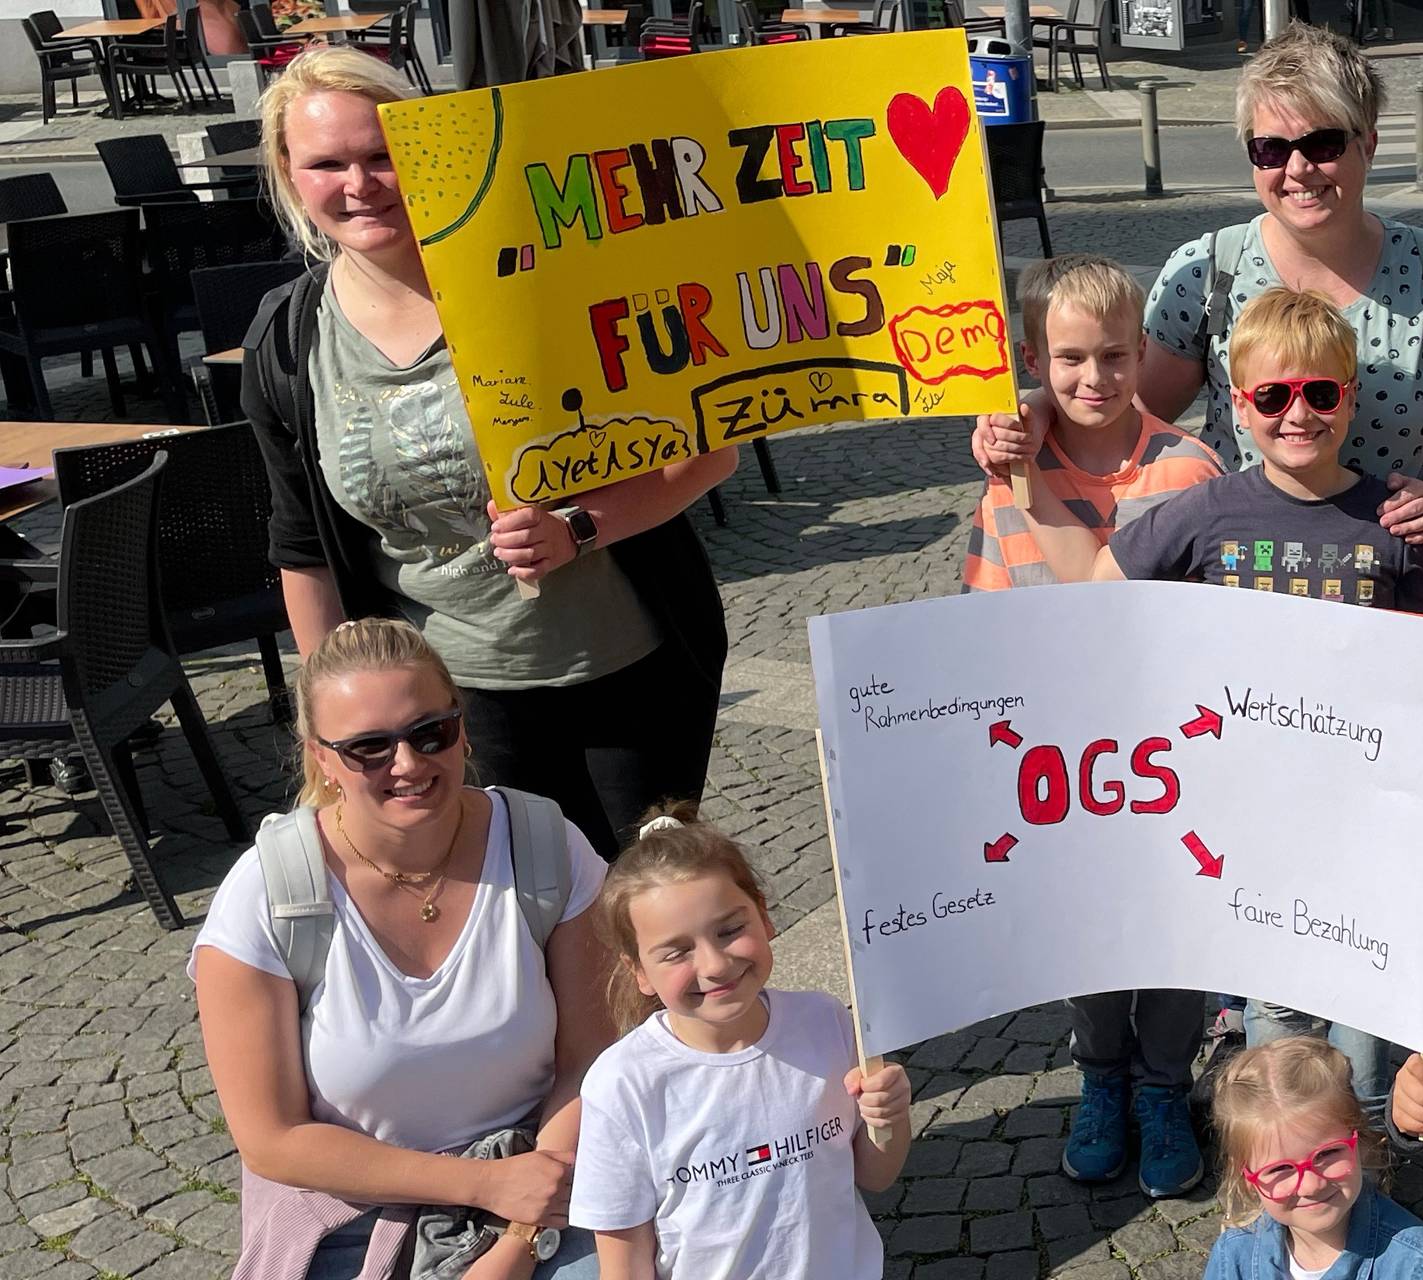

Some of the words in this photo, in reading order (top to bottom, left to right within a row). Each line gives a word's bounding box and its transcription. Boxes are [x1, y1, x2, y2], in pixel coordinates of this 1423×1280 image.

[728, 118, 876, 204] ZEIT
[920, 260, 957, 295] Maja
[590, 281, 729, 392] FÜR
[900, 311, 1006, 363] Demo
[716, 388, 897, 440] Zümra
[440, 564, 468, 579] high
[849, 675, 895, 713] gute
[864, 692, 1025, 733] Rahmenbedingungen
[1224, 685, 1384, 762] Wertschätzung
[1018, 736, 1181, 825] OGS
[861, 907, 928, 945] festes
[931, 887, 997, 921] Gesetz
[1228, 887, 1284, 930] faire
[1293, 897, 1390, 972] Bezahlung
[775, 1116, 844, 1158] HILFIGER
[717, 1175, 740, 1187] THREE
[741, 1164, 771, 1180] CLASSIC
[799, 1151, 814, 1163] TEES
